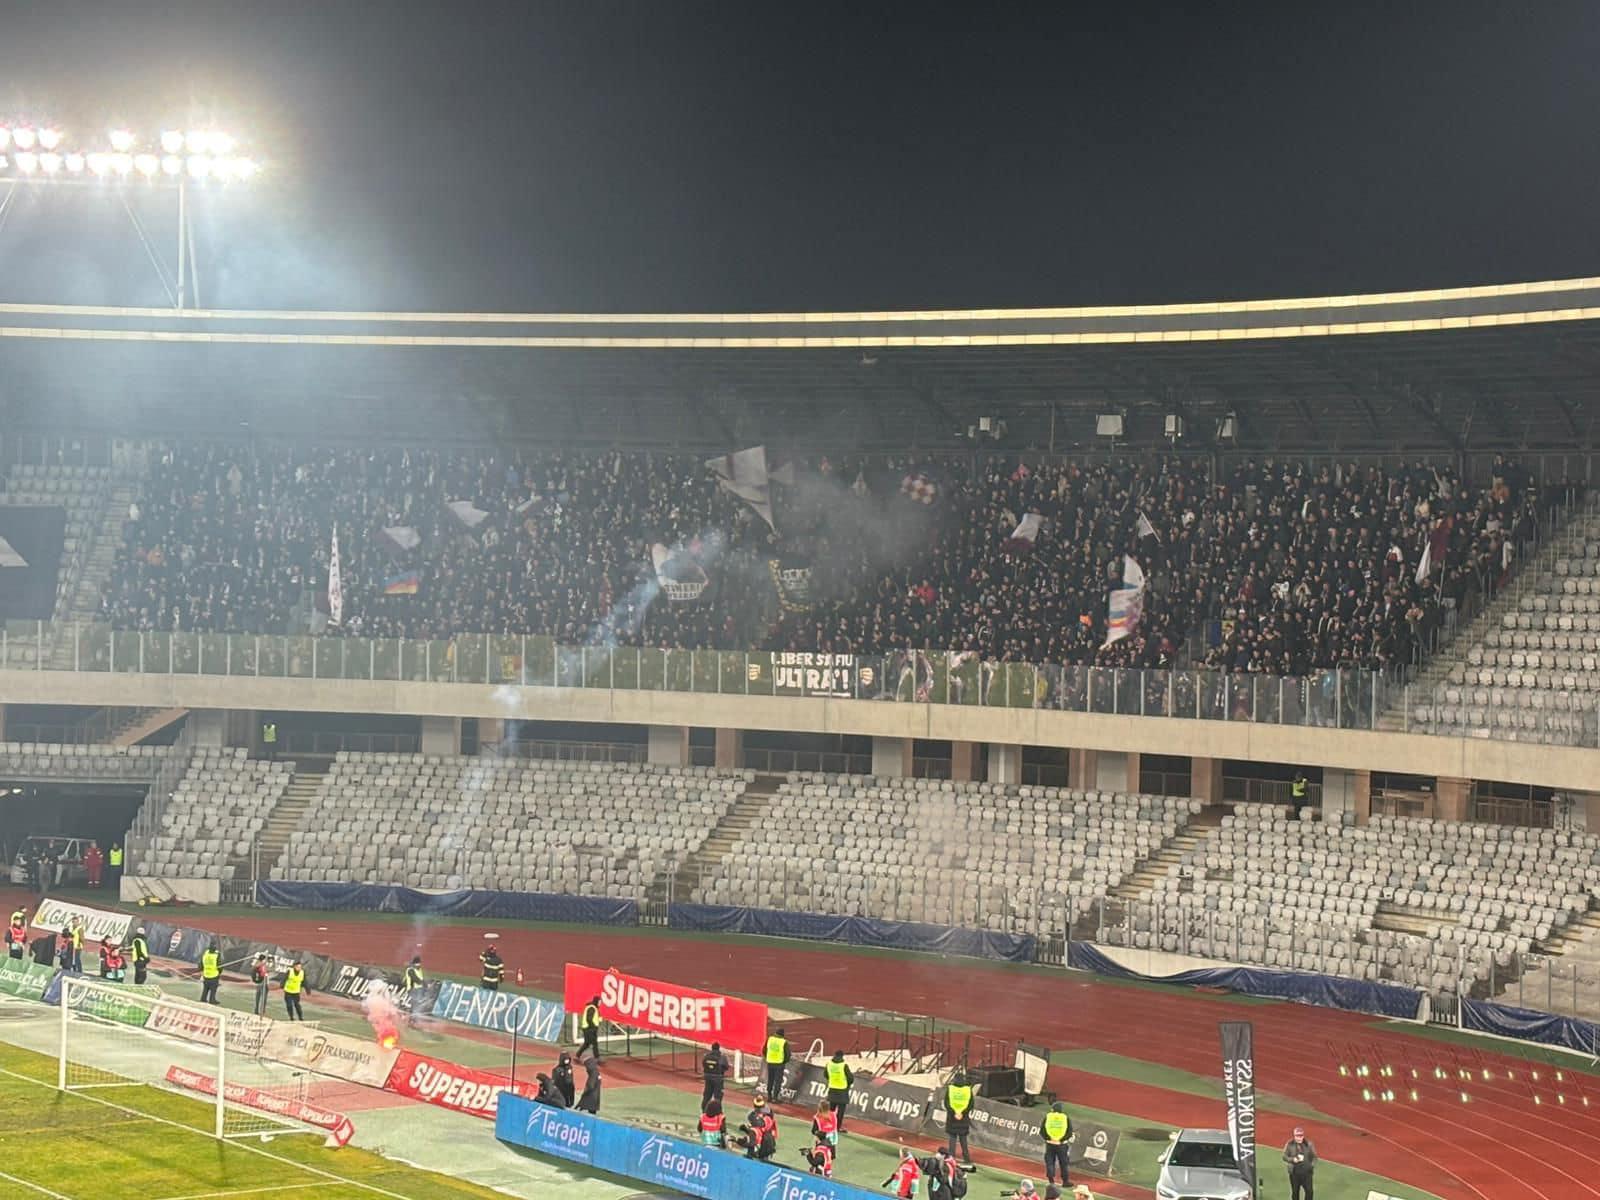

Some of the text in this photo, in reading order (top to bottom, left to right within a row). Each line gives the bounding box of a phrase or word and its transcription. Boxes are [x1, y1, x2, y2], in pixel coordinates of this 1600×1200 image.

[836, 653, 854, 667] FIU
[92, 917, 128, 939] LUNA
[443, 982, 557, 1042] TENROM
[601, 974, 725, 1031] SUPERBET
[539, 1107, 590, 1147] Terapia
[989, 1115, 1017, 1131] mereu
[651, 1138, 709, 1180] Terapia
